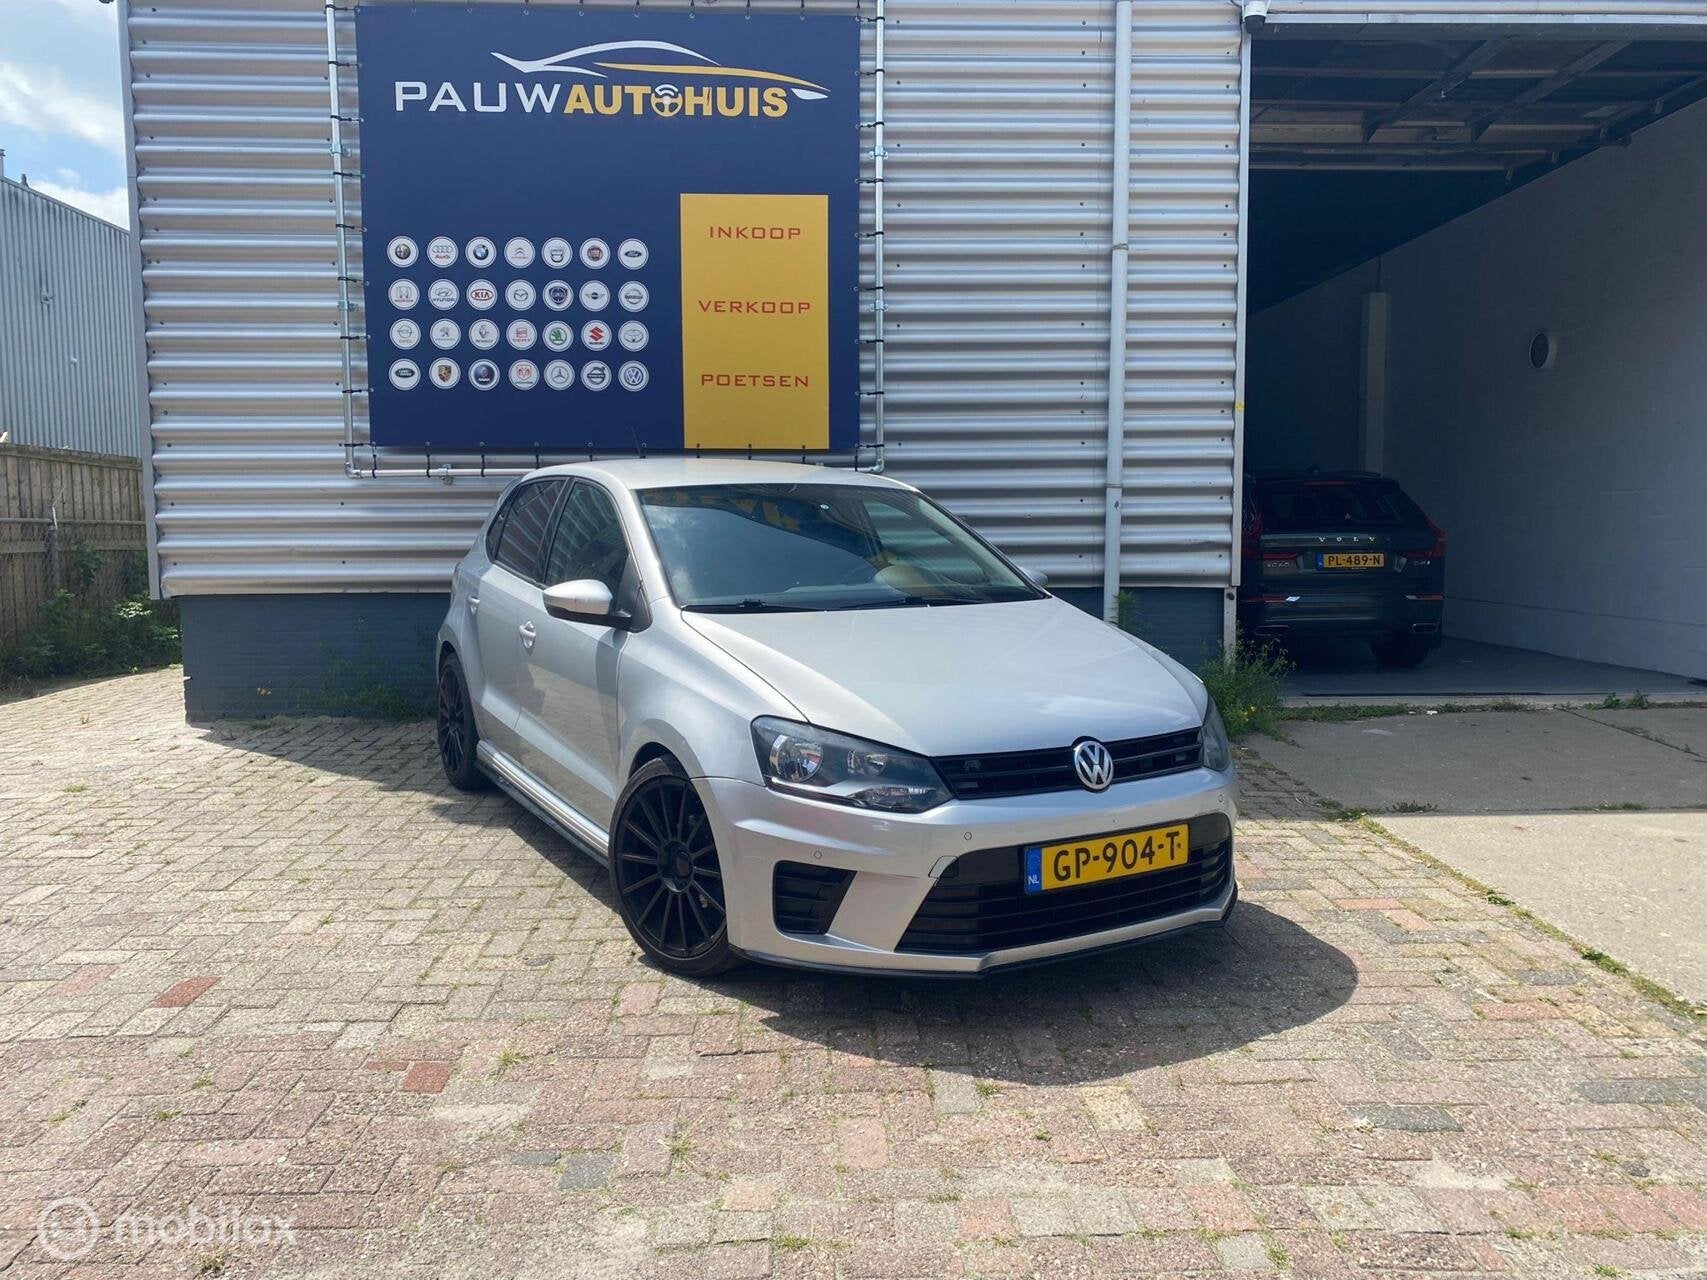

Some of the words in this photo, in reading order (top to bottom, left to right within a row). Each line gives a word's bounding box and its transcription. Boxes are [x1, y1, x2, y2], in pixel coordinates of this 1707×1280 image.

[709, 226, 802, 240] INKOOP
[698, 300, 811, 314] VERKOOP
[701, 373, 809, 388] POETSEN
[1327, 555, 1381, 566] PL-489-N
[1053, 831, 1180, 882] GP-904-T
[1028, 875, 1039, 885] NL
